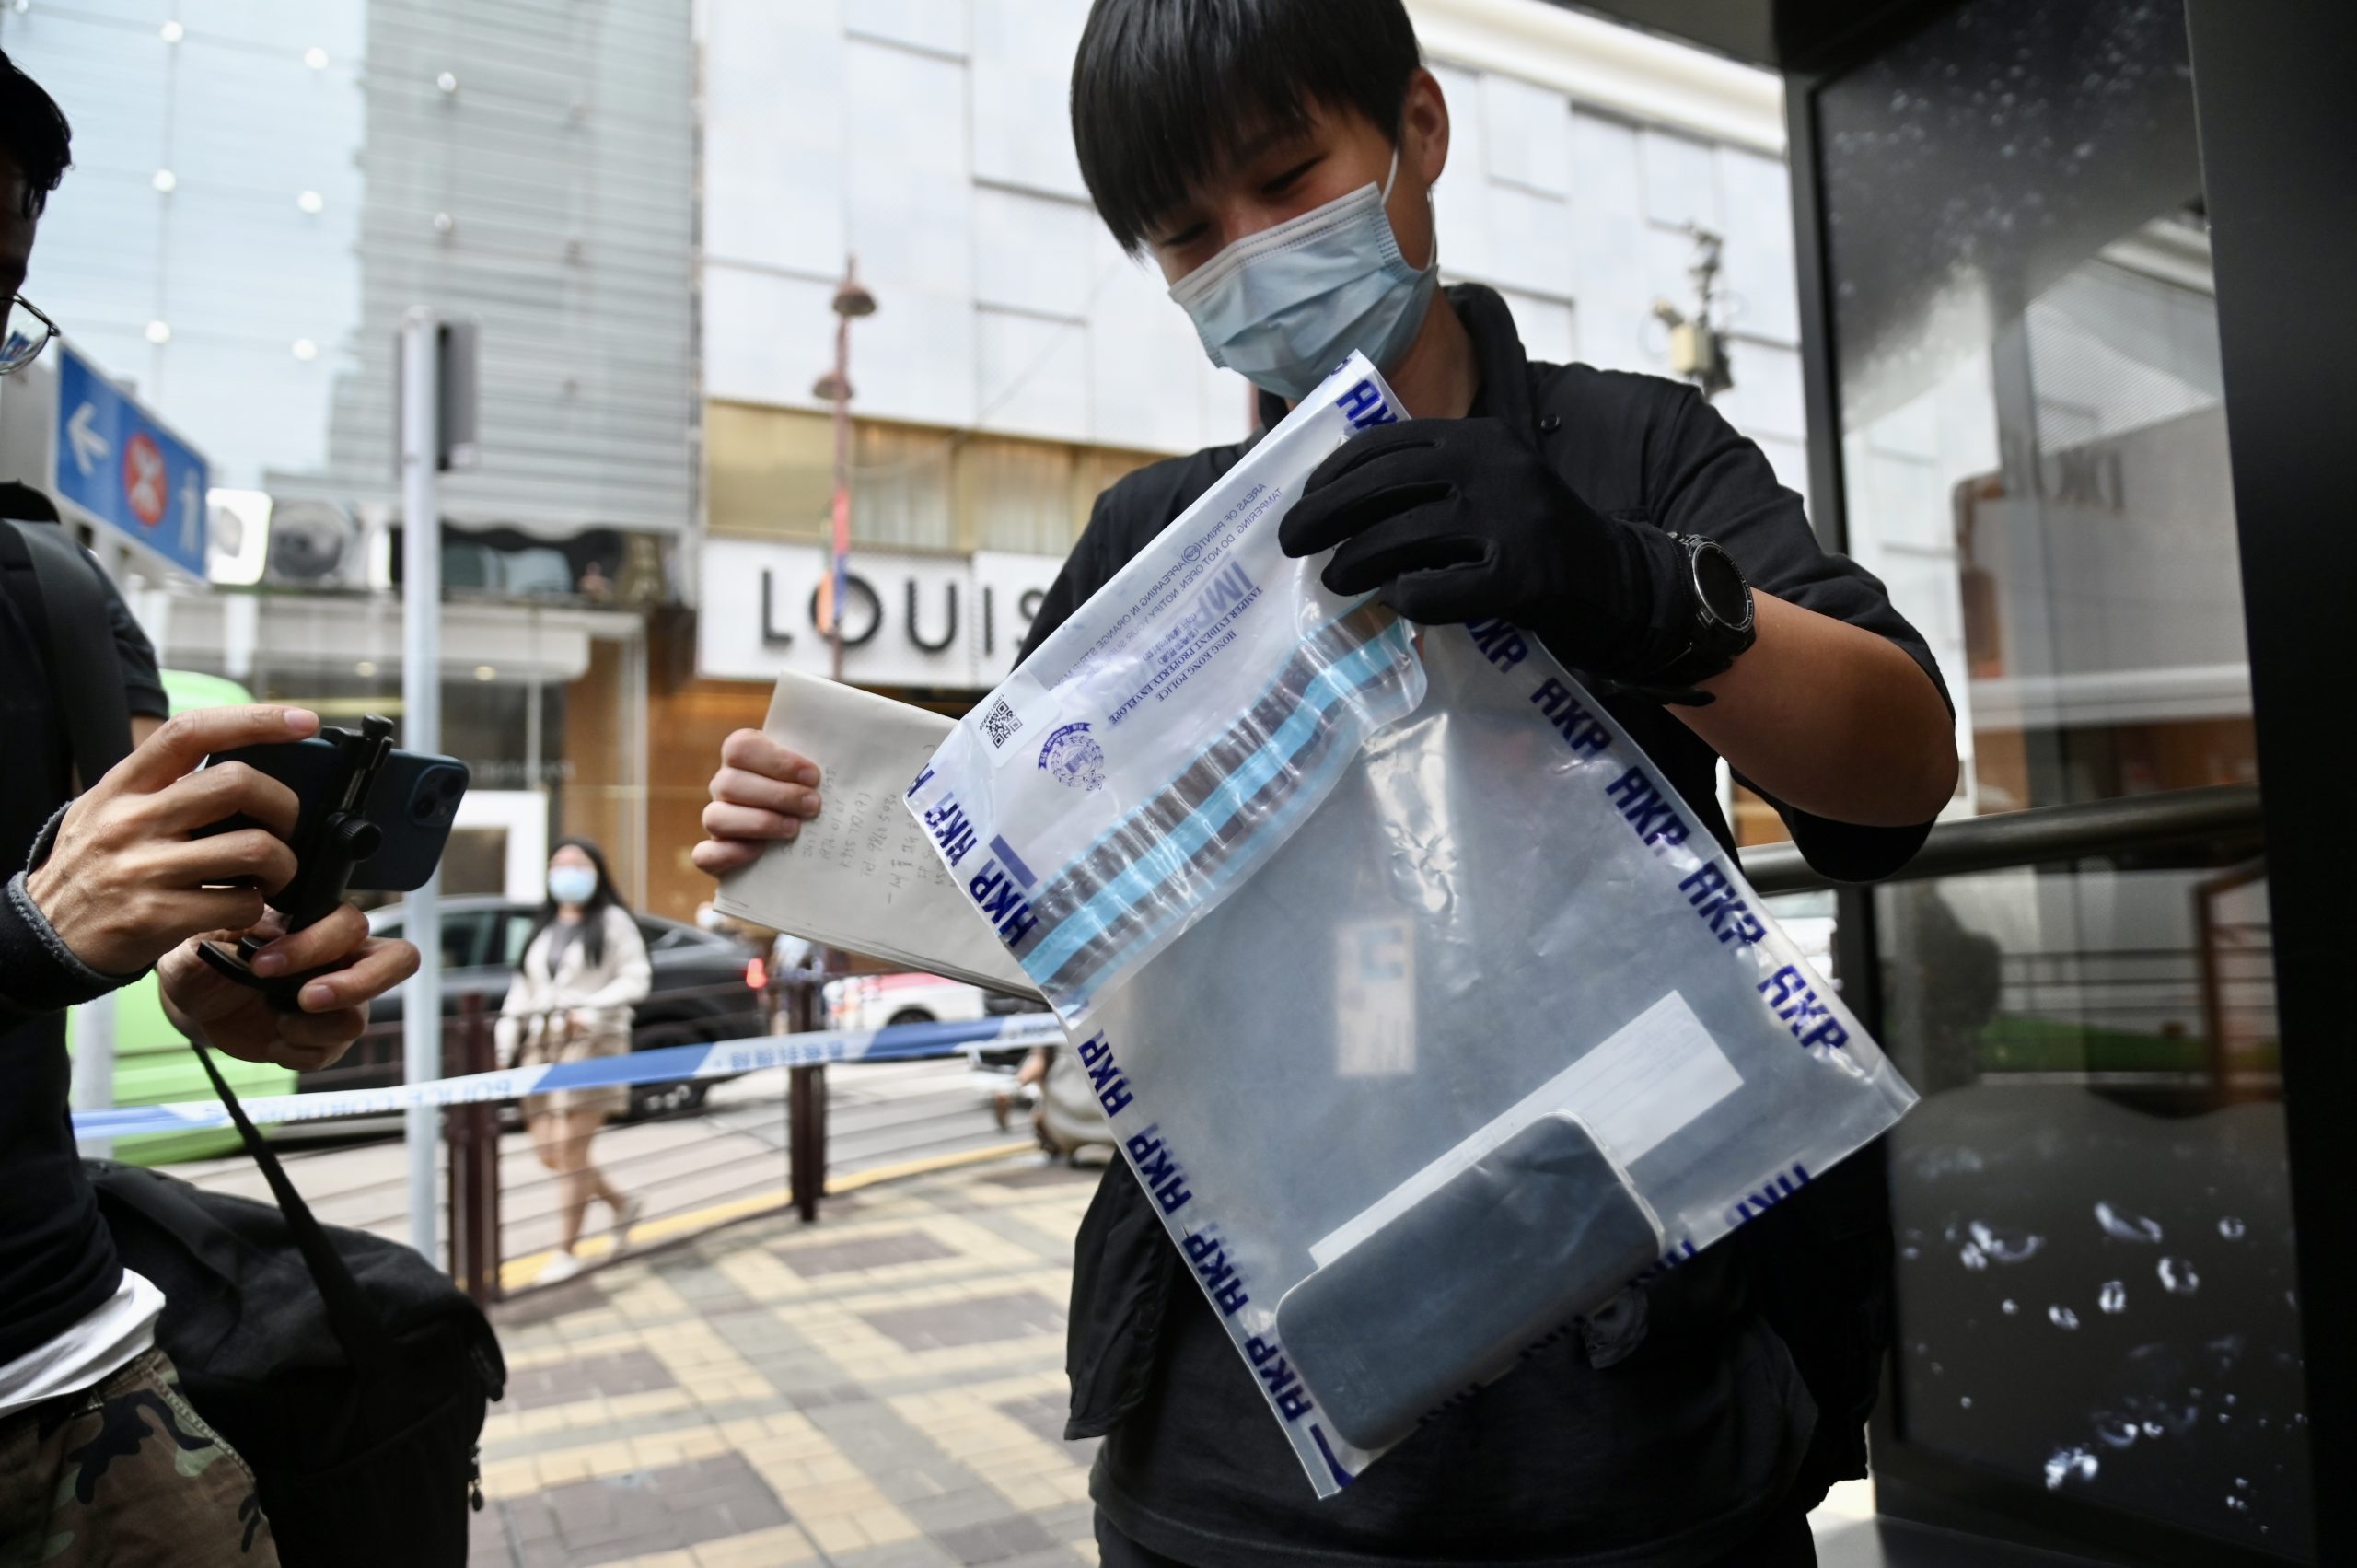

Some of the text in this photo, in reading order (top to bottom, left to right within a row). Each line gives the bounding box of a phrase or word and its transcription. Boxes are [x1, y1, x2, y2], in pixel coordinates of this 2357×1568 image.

[1108, 586, 1263, 724] TAMPER EVIDENT PROPERTY ENVELOPE
[1155, 630, 1236, 702] HONG KONG POLICE
[970, 859, 1039, 948] HKP
